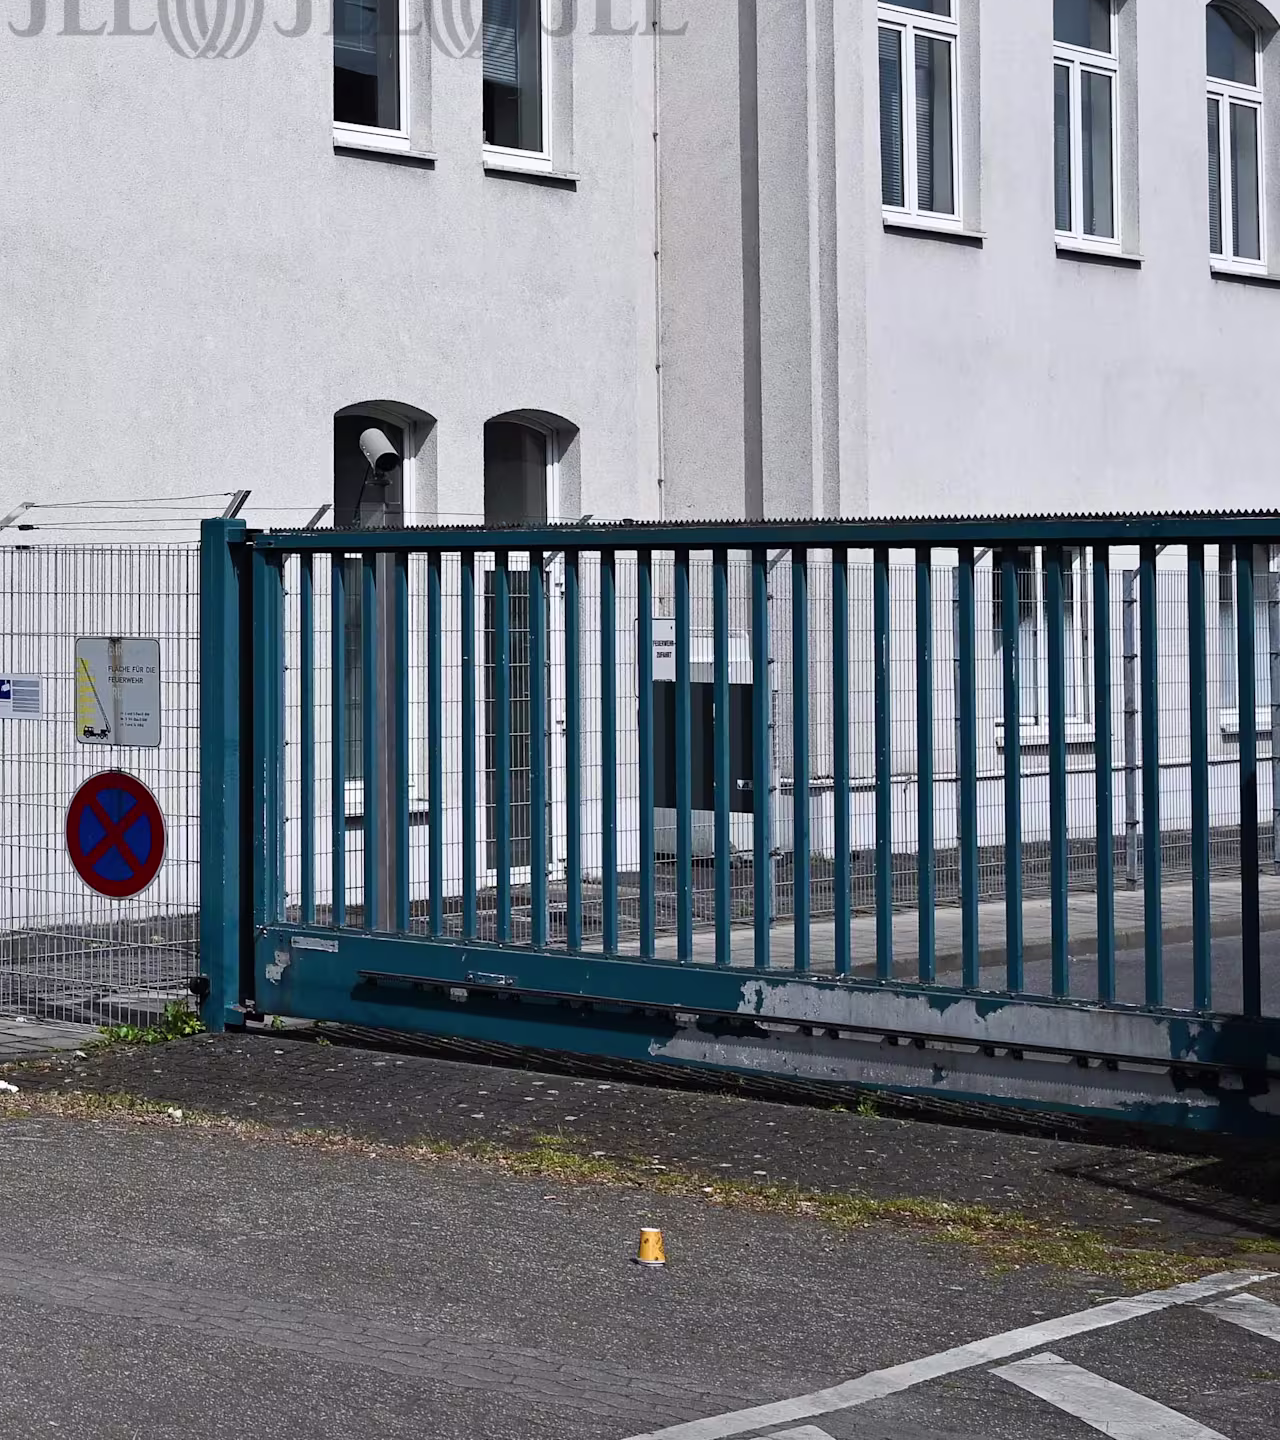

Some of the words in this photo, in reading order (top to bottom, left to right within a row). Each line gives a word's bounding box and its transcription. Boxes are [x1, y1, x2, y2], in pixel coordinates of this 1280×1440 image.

[132, 665, 144, 673] FÜR
[145, 666, 156, 674] DIE
[107, 676, 144, 684] FEUERWEHR
